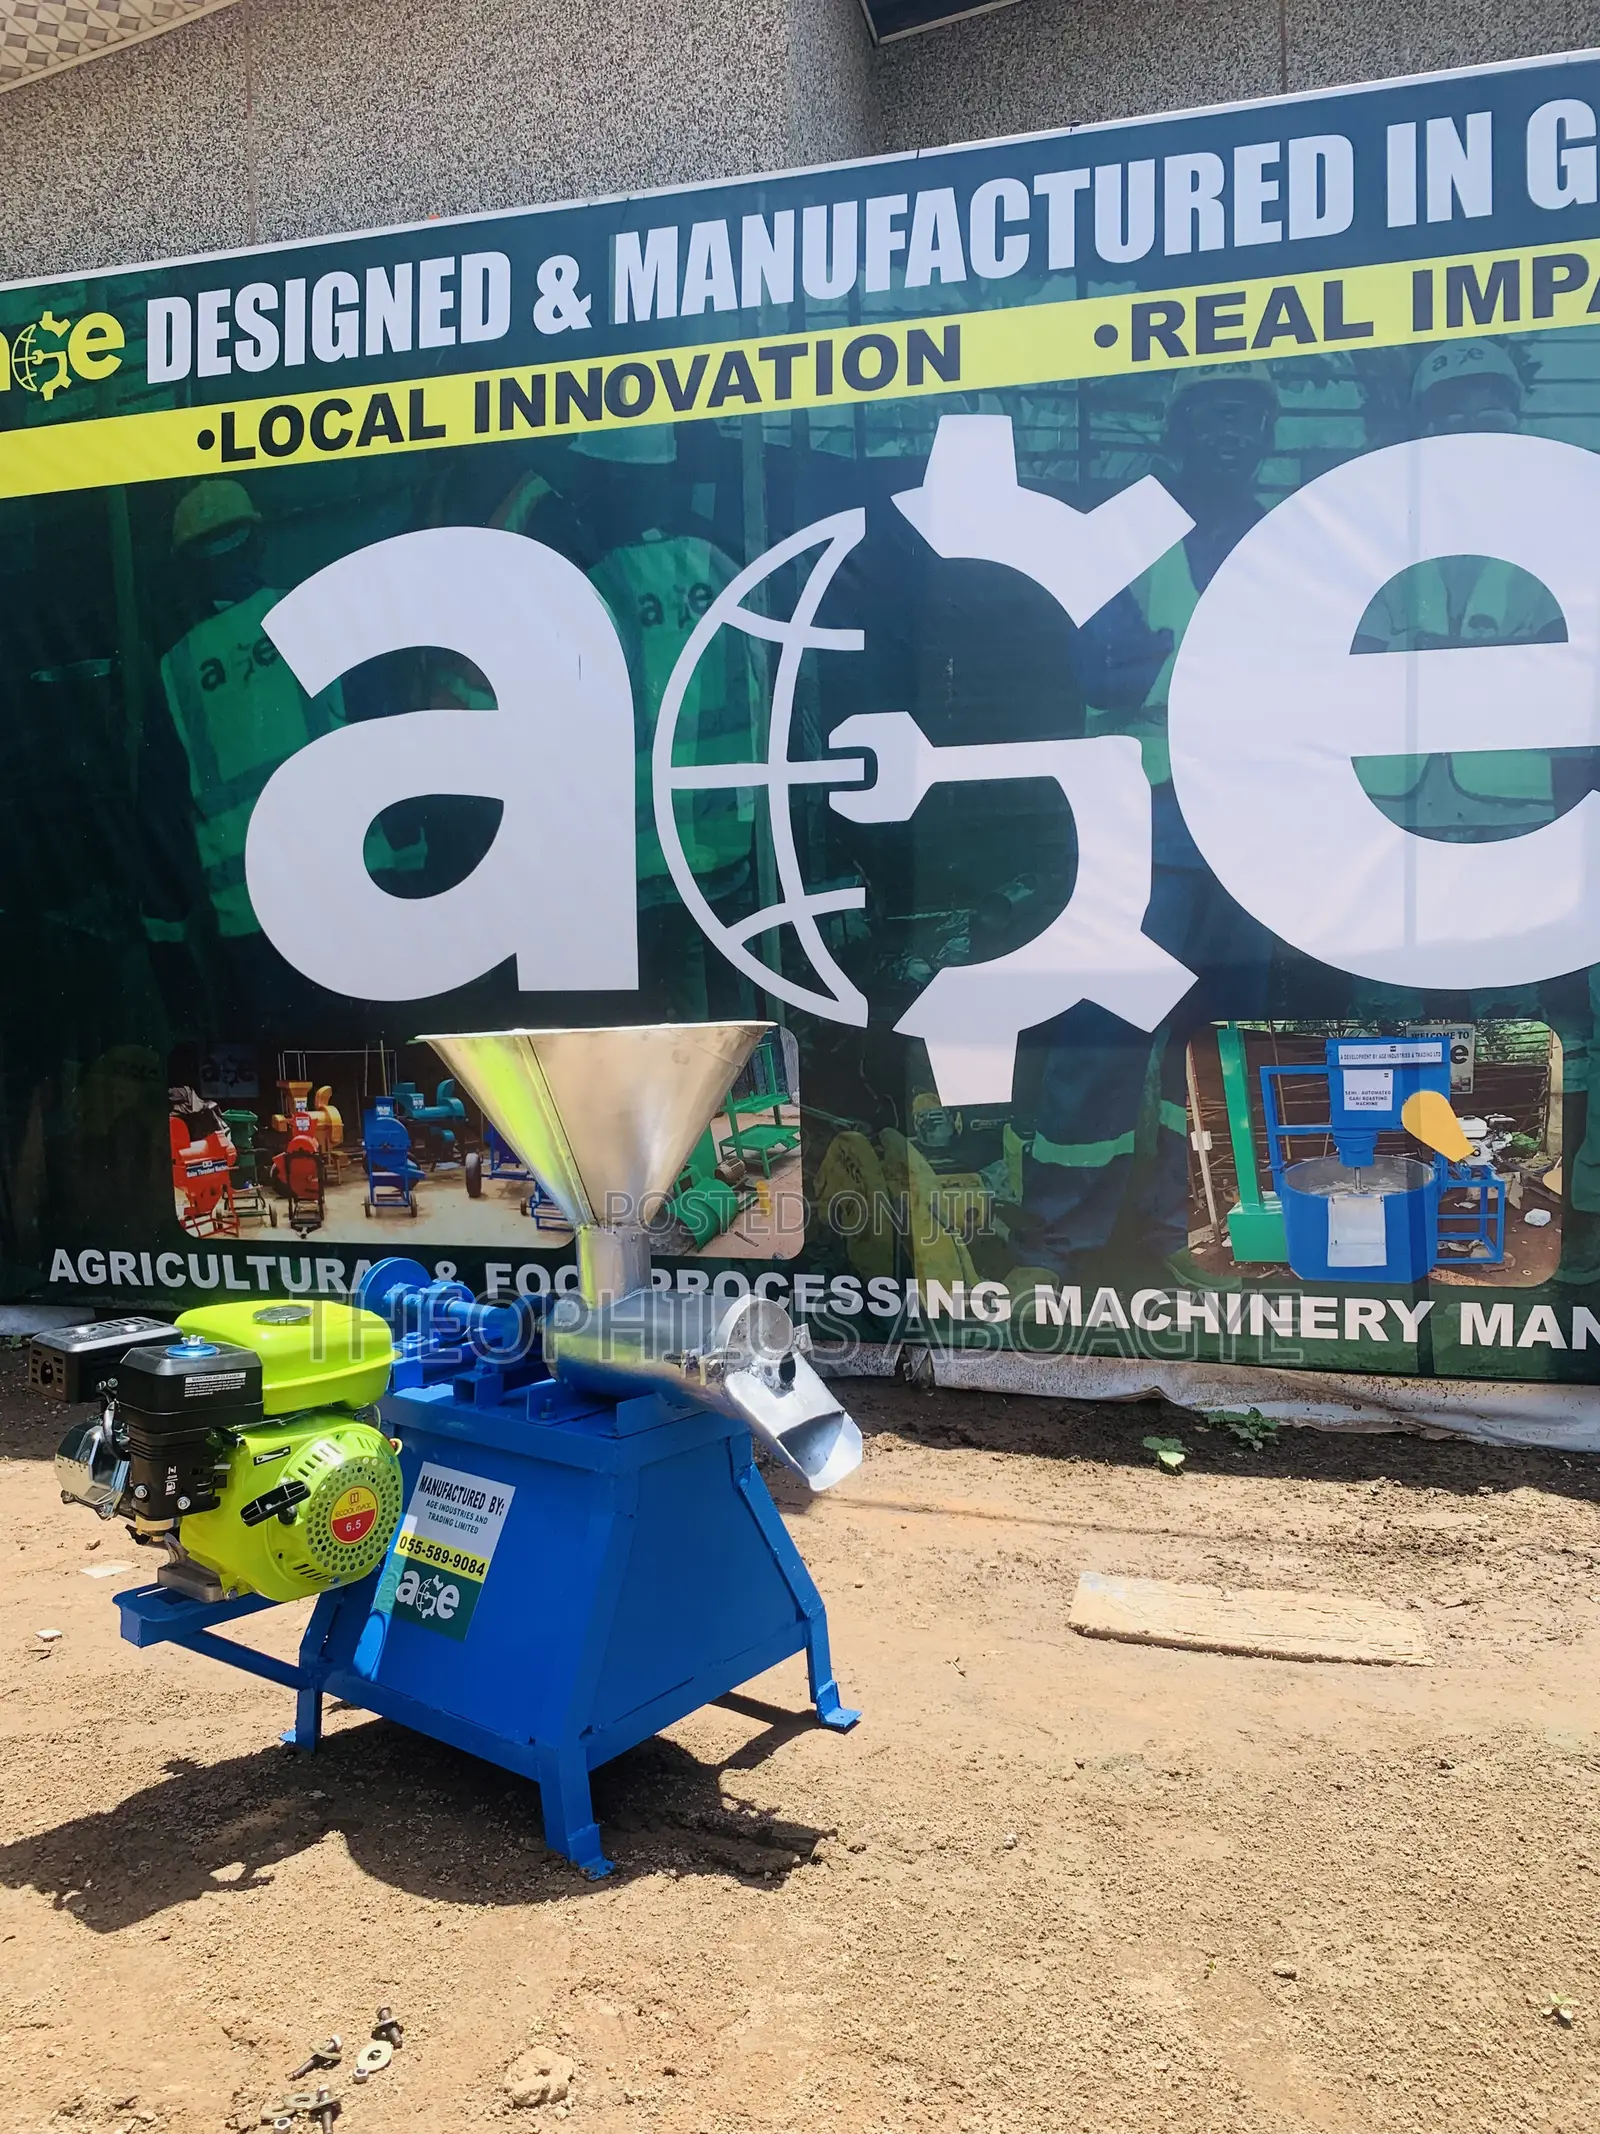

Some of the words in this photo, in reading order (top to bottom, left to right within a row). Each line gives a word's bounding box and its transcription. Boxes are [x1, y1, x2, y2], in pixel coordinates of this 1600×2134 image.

[146, 251, 511, 385] DESIGNED
[531, 254, 592, 336] &
[614, 134, 1355, 325] MANUFACTURED
[1386, 111, 1494, 229] IN
[1412, 253, 1600, 332] IMP
[474, 324, 962, 434] INNOVATION
[49, 1248, 373, 1295] AGRICULTURA
[1034, 1283, 1436, 1343] MACHINERY
[418, 1475, 487, 1510] MANUFACTURED
[488, 1496, 504, 1516] BY:
[425, 1500, 438, 1510] AGE
[438, 1502, 474, 1521] INDUSTRIES
[474, 1514, 489, 1525] AND
[346, 1519, 362, 1532] 6.5
[428, 1512, 454, 1526] TRADING
[454, 1518, 479, 1534] LIMITED
[399, 1536, 486, 1577] 055-589-9084
